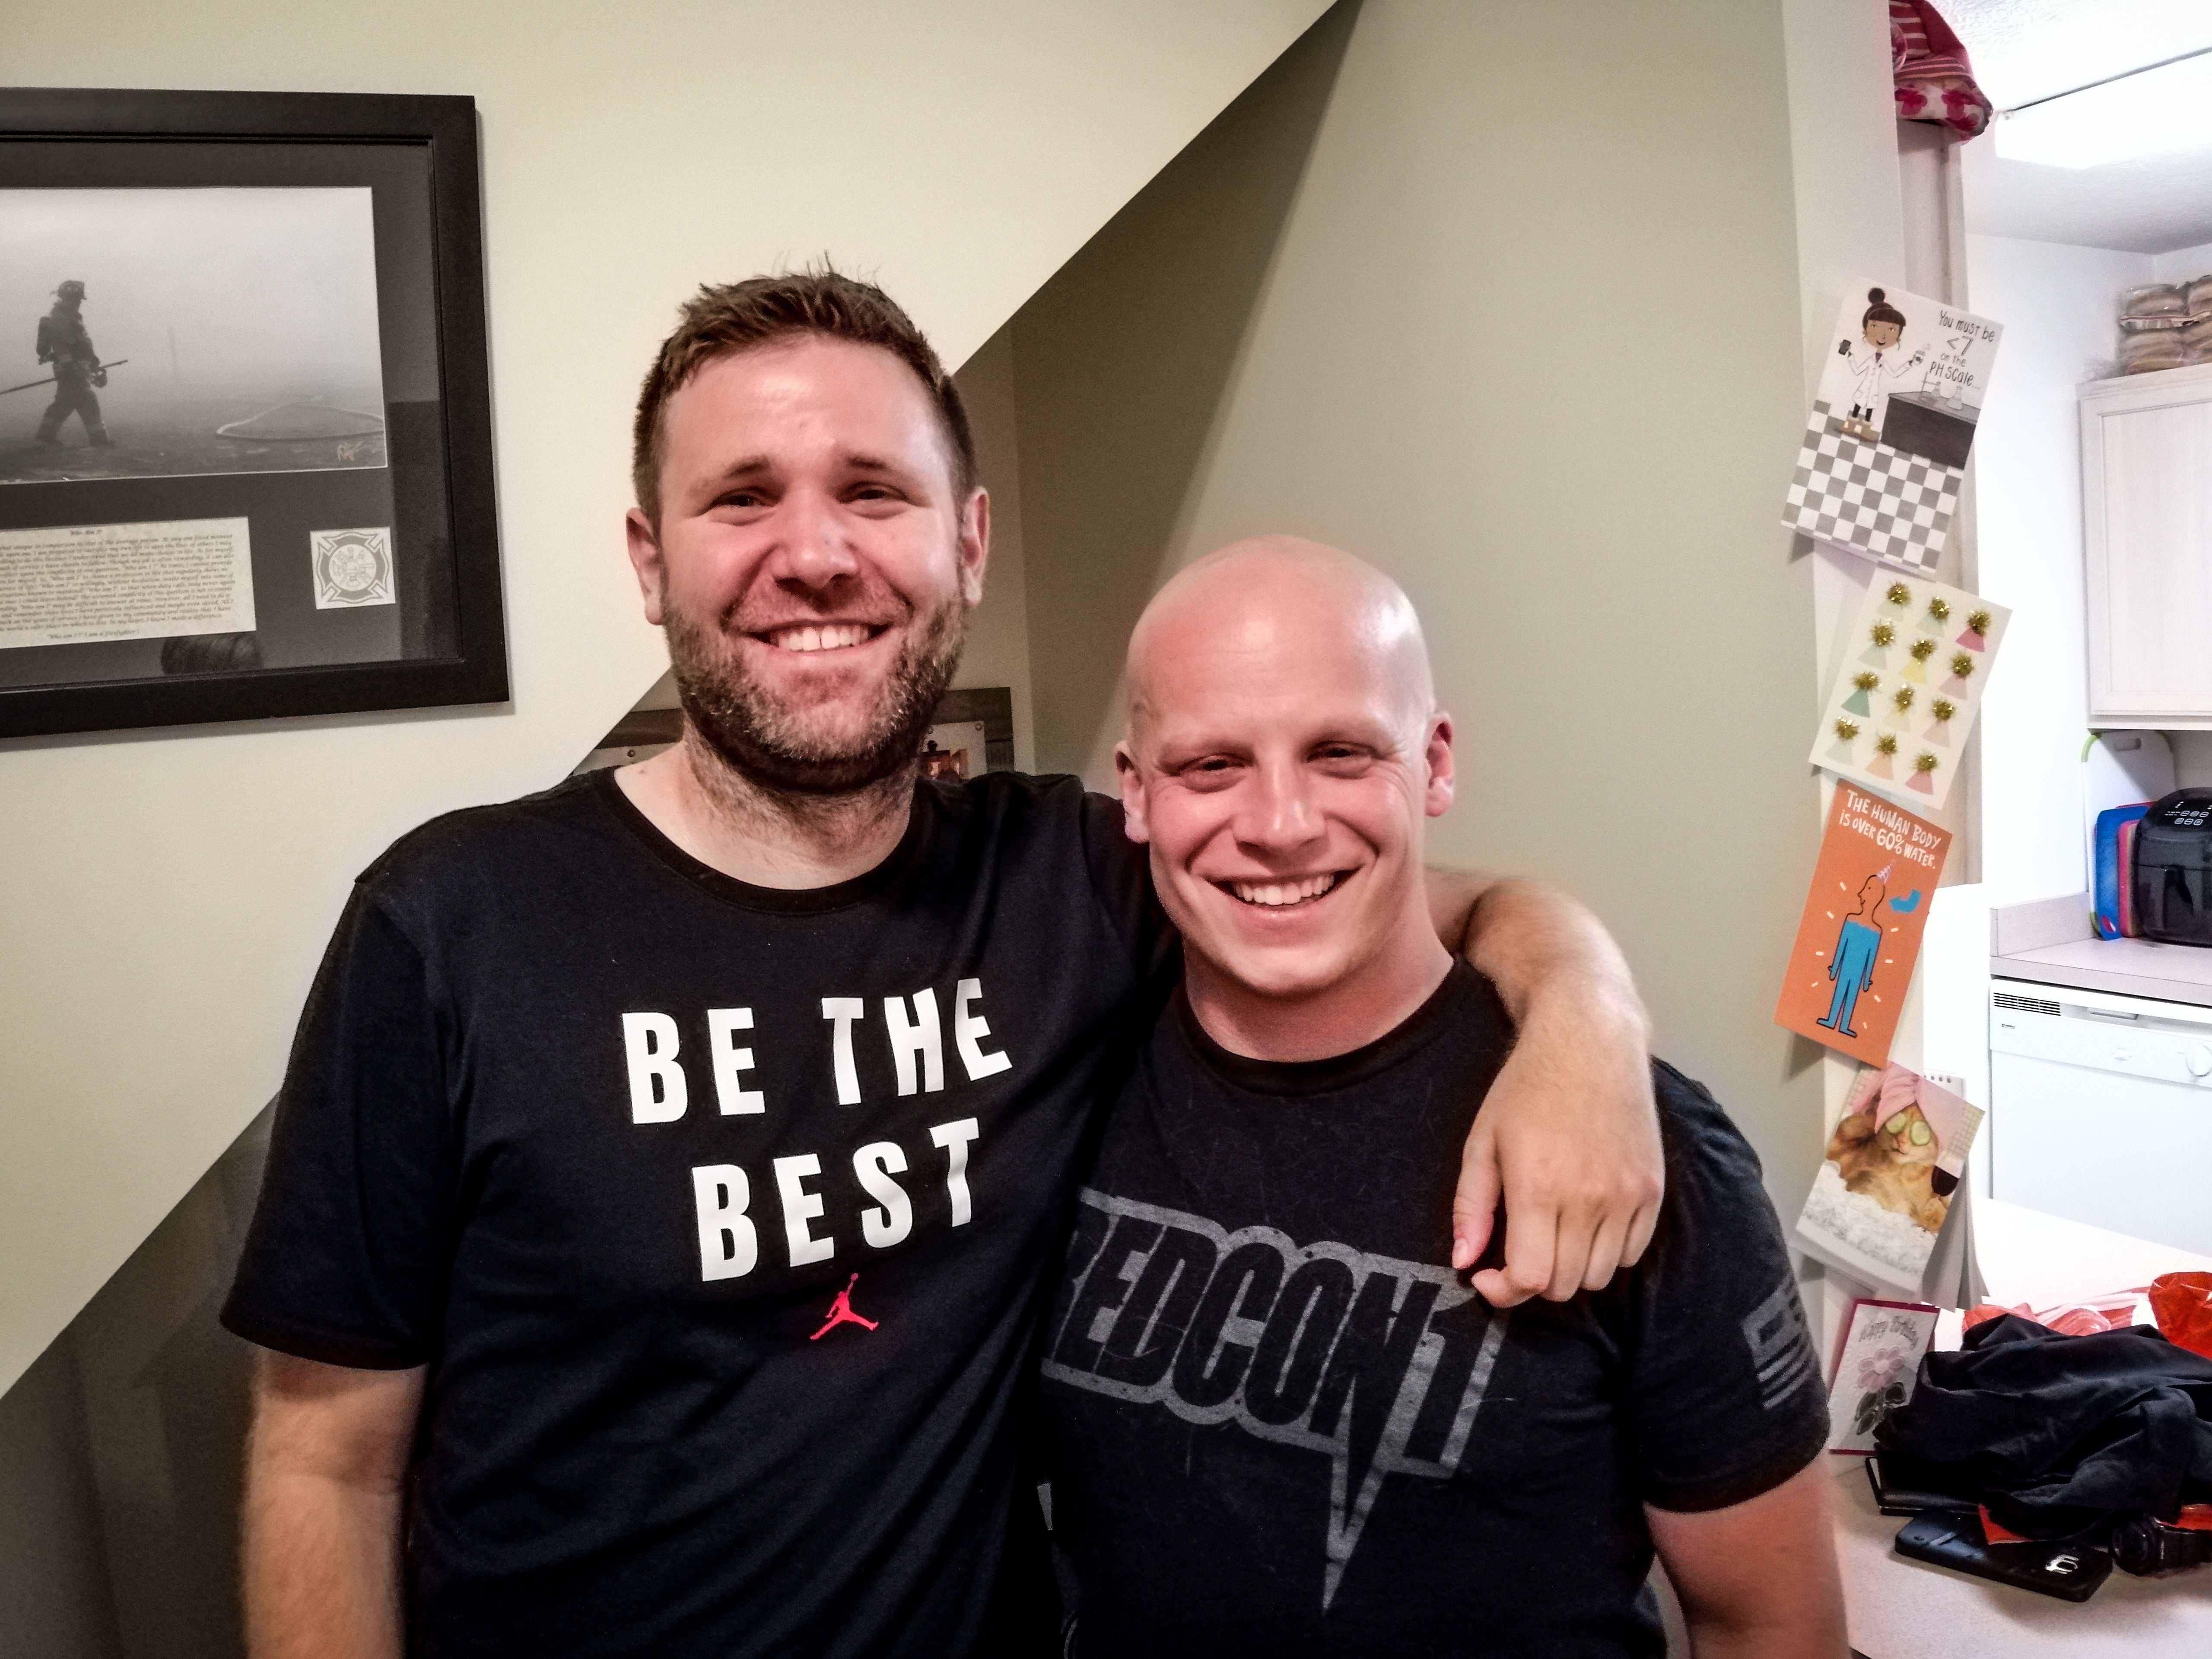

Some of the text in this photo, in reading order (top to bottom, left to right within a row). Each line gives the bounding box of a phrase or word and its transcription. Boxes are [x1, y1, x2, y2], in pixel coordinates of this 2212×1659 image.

[1939, 310, 1996, 342] You must be
[1947, 336, 1974, 356] <7
[1952, 355, 1966, 367] the
[1847, 789, 1942, 849] THE HUMAN BODY
[1852, 818, 1876, 839] OVER
[1877, 828, 1905, 855] 60%
[1903, 843, 1936, 869] WATER.
[621, 977, 1014, 1125] BE THE
[691, 1117, 980, 1282] BEST
